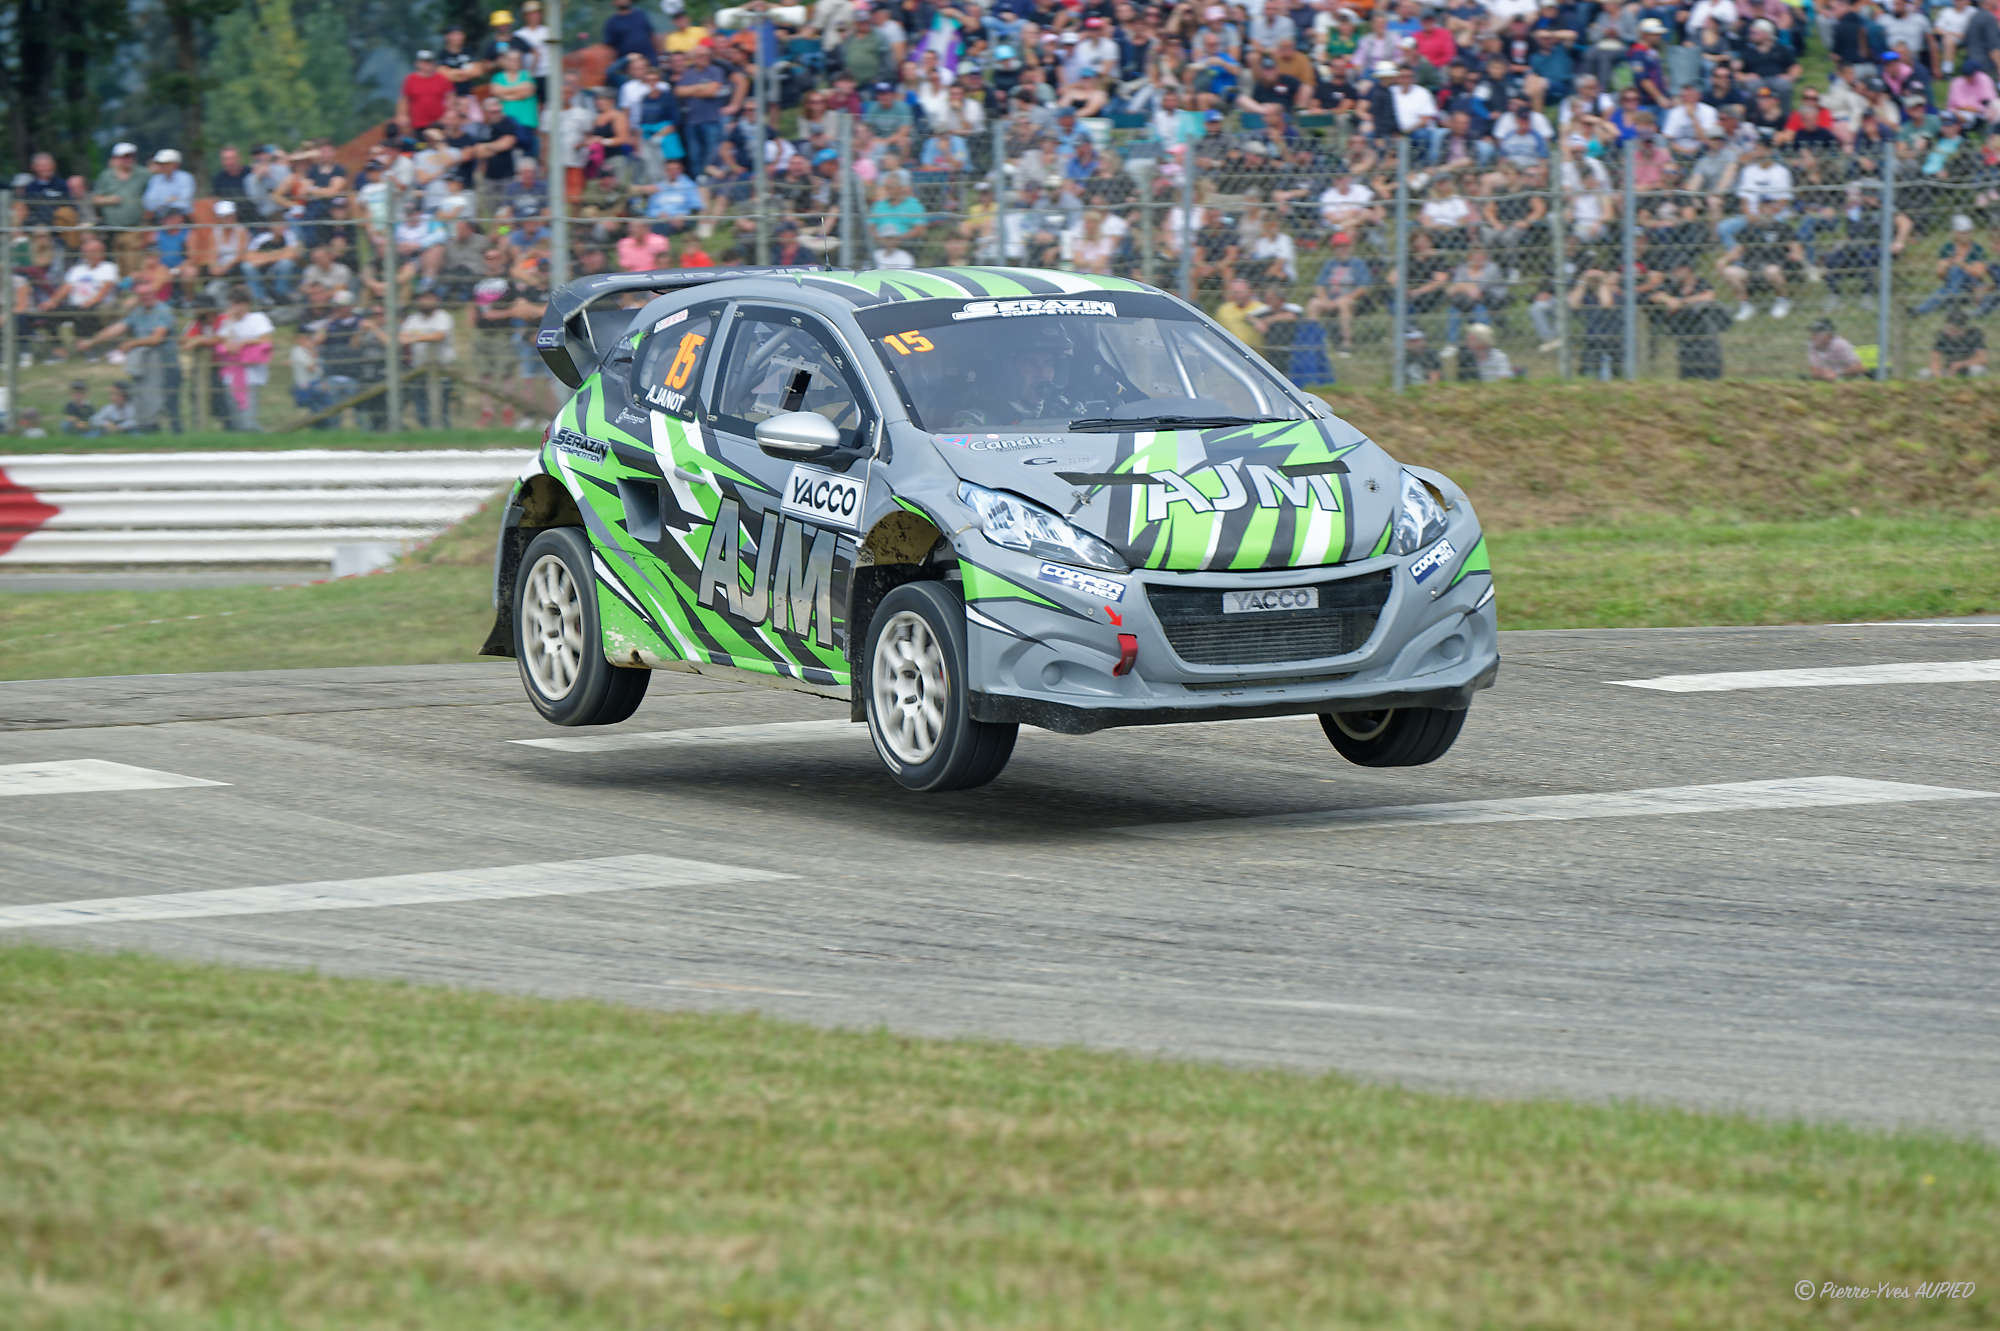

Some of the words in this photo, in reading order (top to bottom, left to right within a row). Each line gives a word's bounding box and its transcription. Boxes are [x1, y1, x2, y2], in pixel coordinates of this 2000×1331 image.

[952, 299, 1118, 320] SERAZIN
[1002, 308, 1107, 318] COMPETITION
[883, 329, 936, 356] 15
[664, 332, 706, 390] 15
[551, 427, 609, 459] SERAZIN
[560, 445, 601, 463] COMPETITION
[792, 475, 858, 517] YACCO
[1146, 464, 1341, 522] AJM
[697, 495, 839, 650] AJM
[1410, 539, 1451, 577] COOPER
[1434, 548, 1456, 568] TIRES
[1040, 563, 1126, 595] COOPER
[1077, 582, 1121, 601] TIRES
[1232, 589, 1310, 610] YACCO
